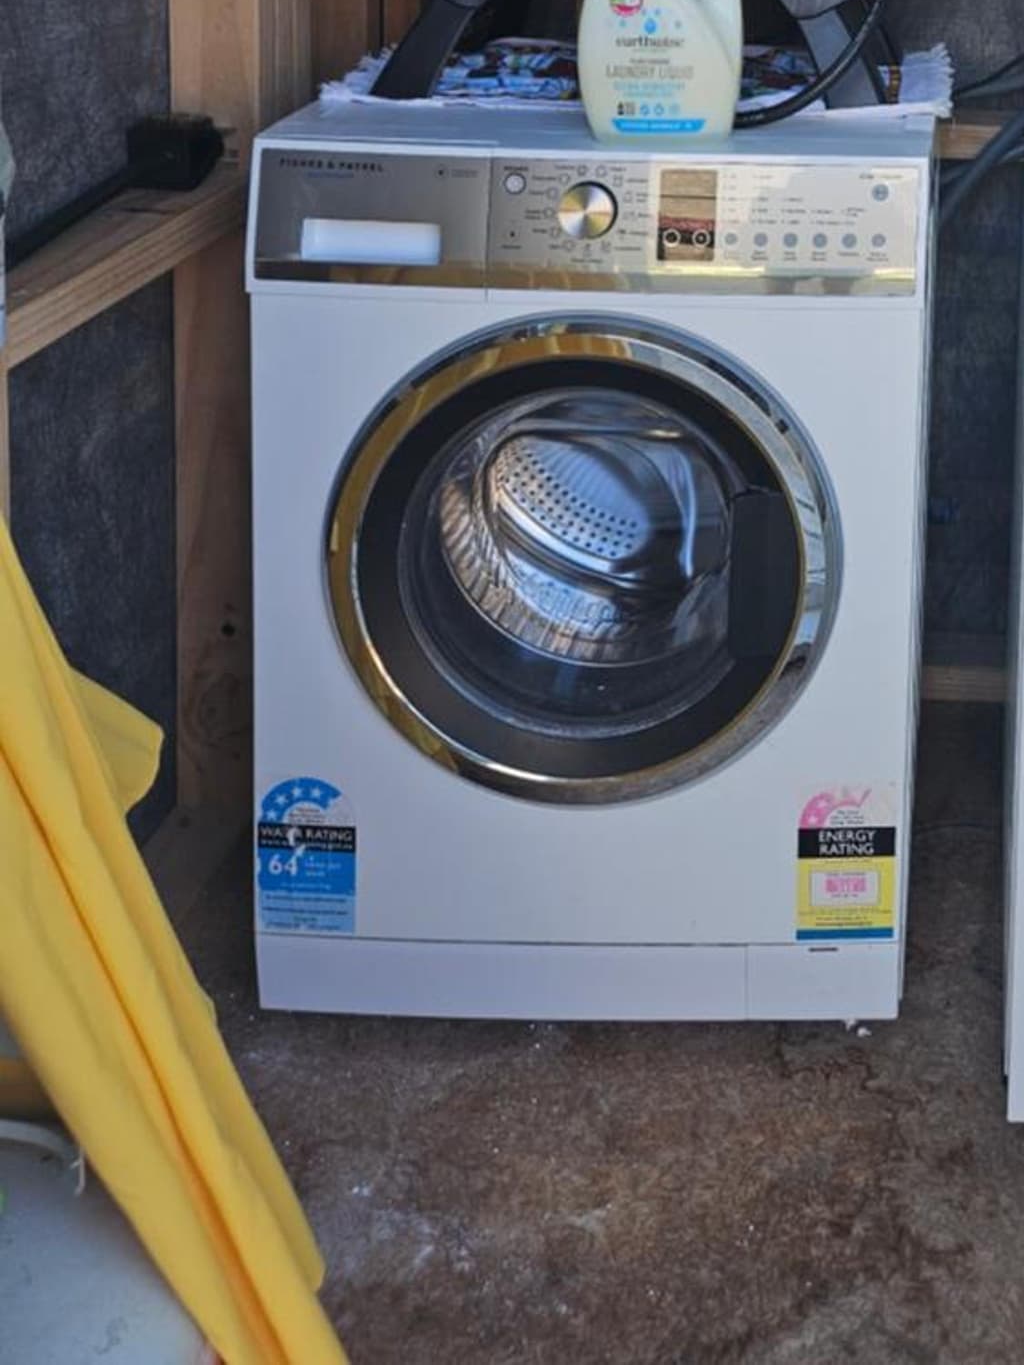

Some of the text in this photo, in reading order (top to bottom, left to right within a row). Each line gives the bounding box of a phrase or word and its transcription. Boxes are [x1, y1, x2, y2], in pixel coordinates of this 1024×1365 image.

[339, 161, 385, 173] PAYKEL
[260, 825, 354, 842] WAR RATING
[818, 830, 876, 843] ENERGY
[819, 843, 875, 856] RATING
[268, 854, 298, 876] 64
